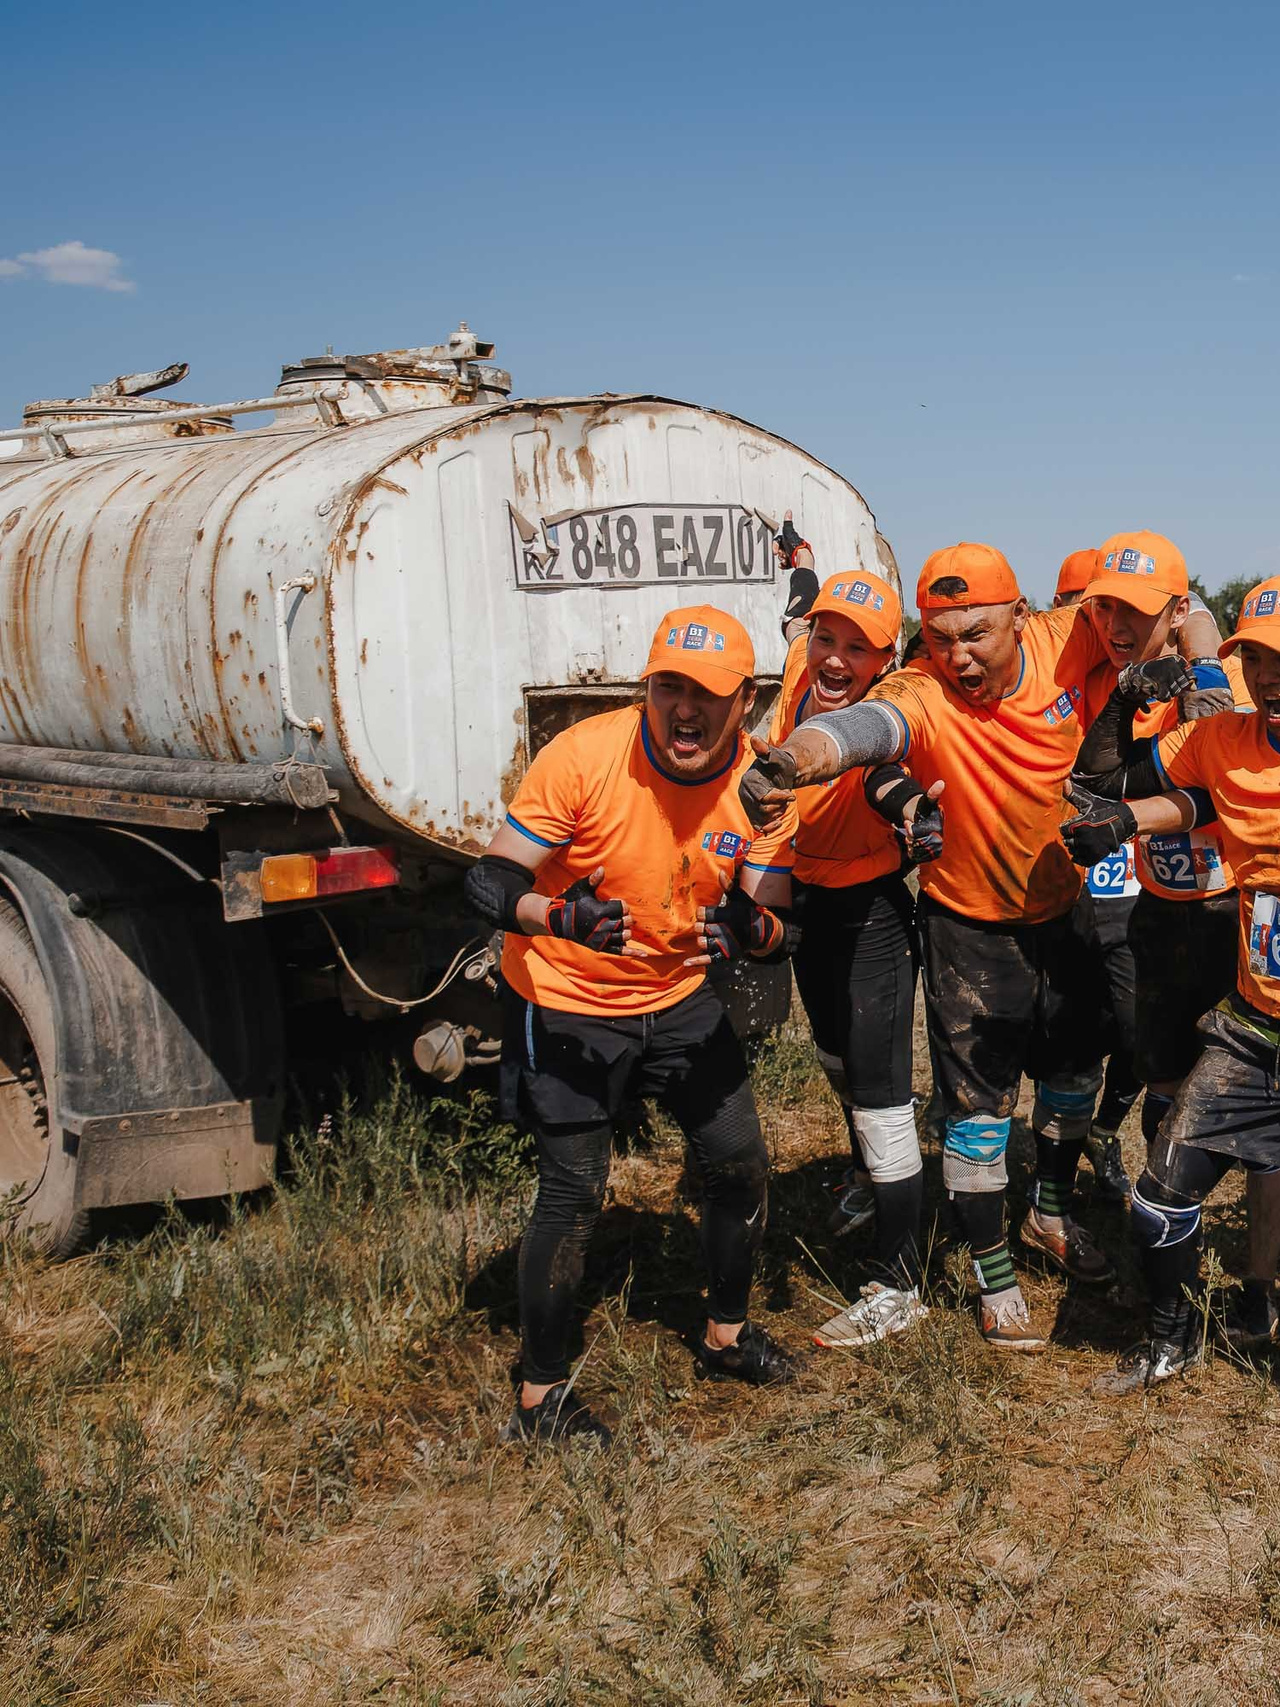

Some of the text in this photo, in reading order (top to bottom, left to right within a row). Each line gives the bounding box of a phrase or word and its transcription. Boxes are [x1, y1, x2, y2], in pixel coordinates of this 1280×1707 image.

[522, 515, 770, 580] KZ 848 EAZ 01
[1123, 552, 1136, 560] BI
[854, 584, 867, 594] BI
[1260, 593, 1274, 603] BI
[689, 627, 704, 637] BI
[1057, 694, 1068, 706] BI
[723, 835, 737, 845] BI
[1149, 841, 1165, 851] BI
[1151, 853, 1196, 882] 62
[1092, 861, 1126, 888] 62
